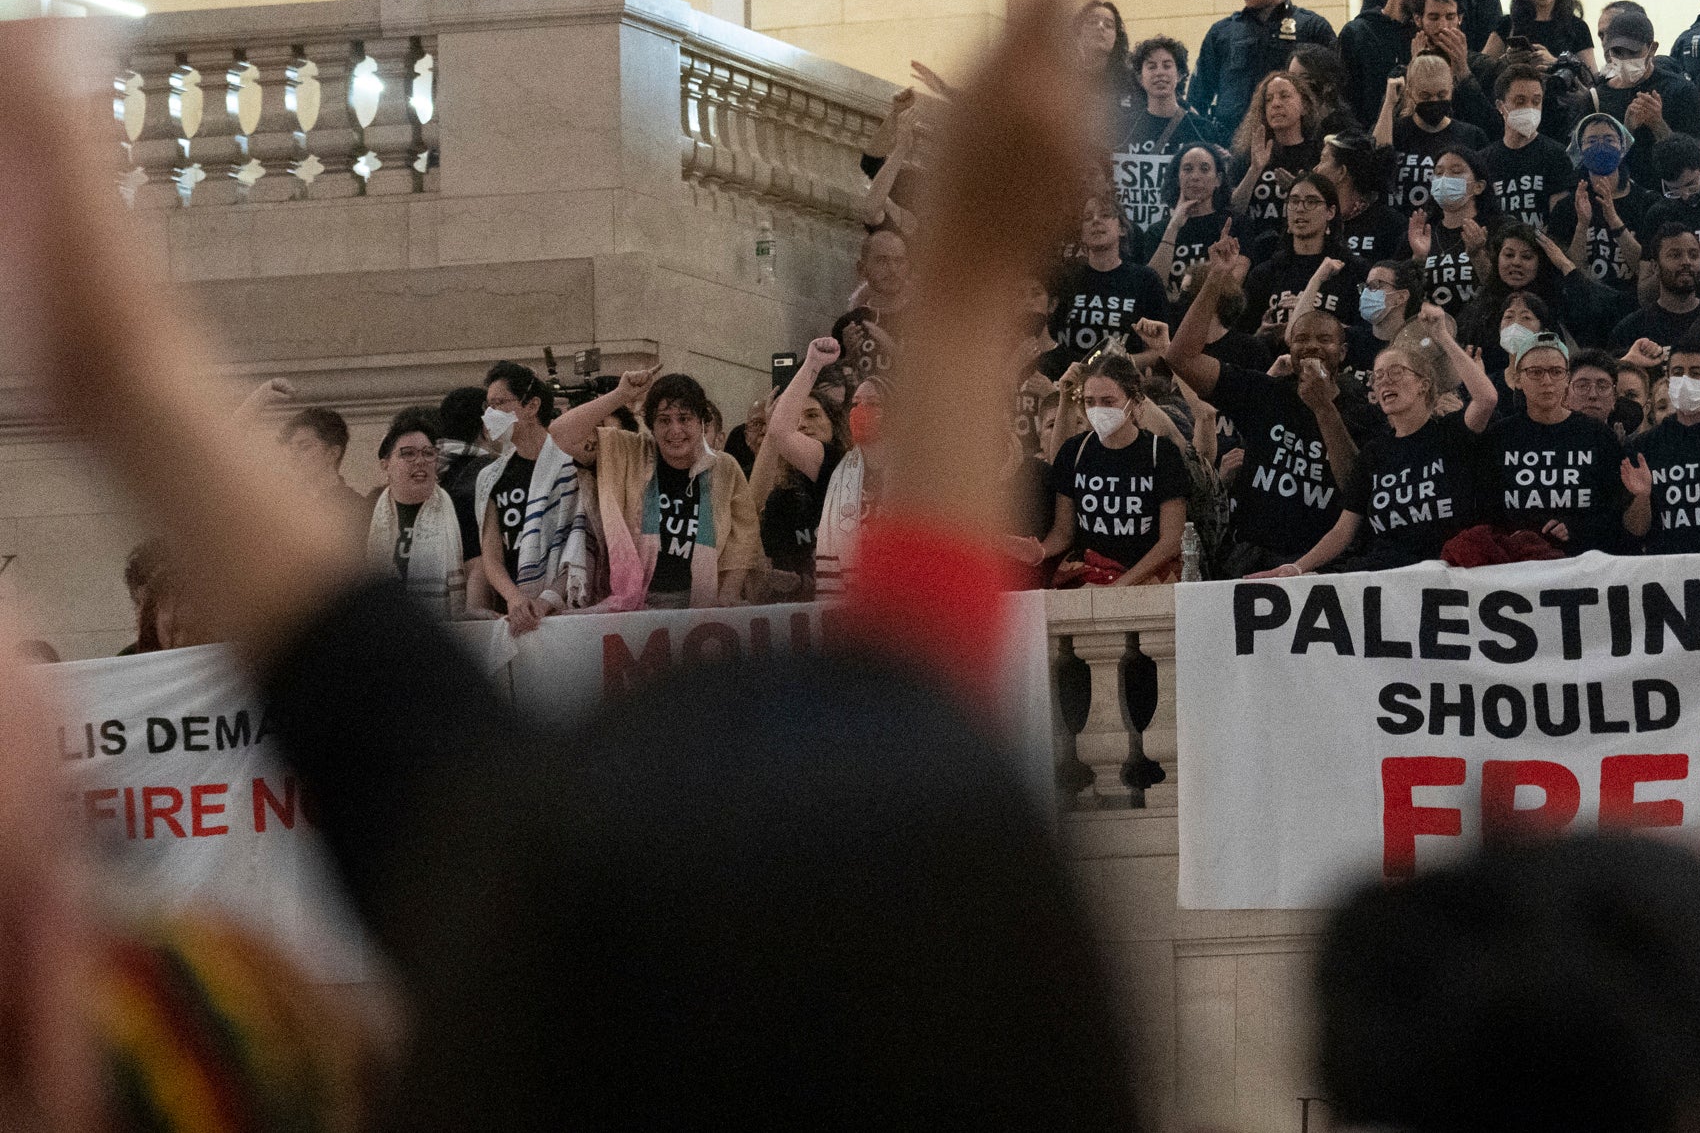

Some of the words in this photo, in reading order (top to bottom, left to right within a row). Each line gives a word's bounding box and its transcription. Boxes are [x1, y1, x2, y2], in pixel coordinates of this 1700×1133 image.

[1399, 167, 1435, 182] FIR
[1388, 185, 1429, 206] NO
[1493, 175, 1543, 196] EASE
[1501, 193, 1536, 211] IRE
[1175, 243, 1203, 257] OT
[1425, 252, 1470, 268] EAS
[1430, 266, 1472, 284] IRE
[1074, 294, 1136, 312] EASE
[1270, 424, 1329, 460] CEAS
[1272, 447, 1323, 482] FIRE
[1422, 458, 1445, 479] IN
[1504, 450, 1556, 466] NOT
[1567, 450, 1593, 465] IN
[1074, 472, 1120, 492] NOT
[1130, 475, 1154, 492] IN
[1515, 468, 1580, 486] OUR
[1652, 463, 1699, 485] NOT
[497, 488, 525, 507] NO
[1251, 465, 1334, 510] NOW
[1372, 480, 1436, 510] OUR
[659, 493, 683, 515] OT
[1081, 494, 1142, 515] OUR
[1504, 488, 1592, 509] NAME
[659, 514, 699, 537] UR
[1077, 512, 1153, 536] NAME
[1369, 498, 1453, 535] NAME
[1376, 678, 1681, 739] SHOULD
